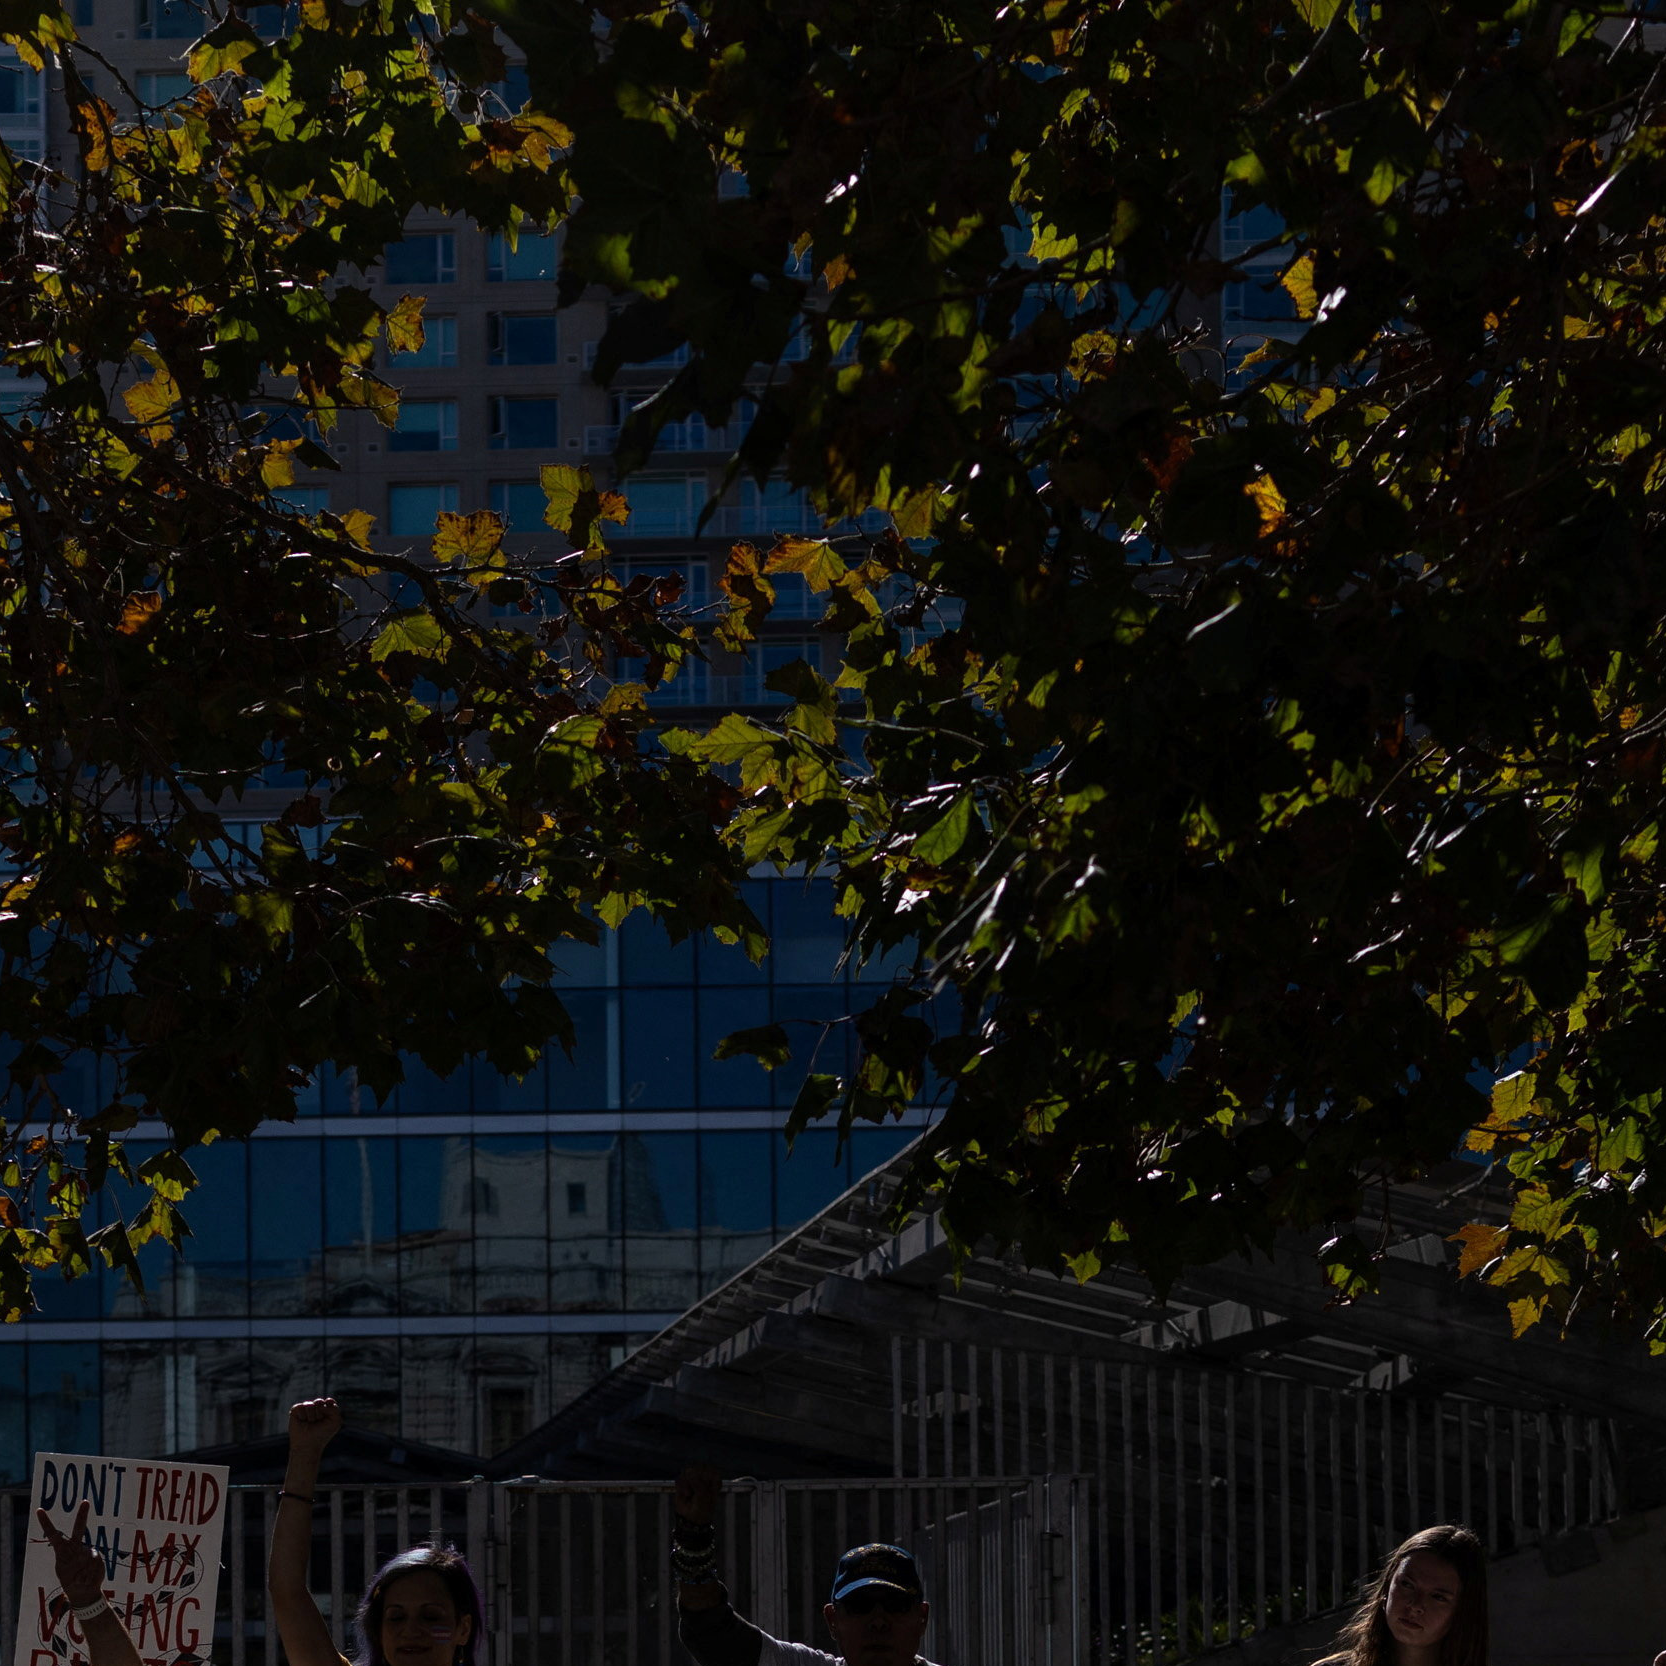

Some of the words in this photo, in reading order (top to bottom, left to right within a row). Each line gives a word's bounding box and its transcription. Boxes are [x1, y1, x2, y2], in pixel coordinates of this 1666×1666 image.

[40, 1460, 127, 1517] DON'T
[136, 1467, 220, 1526] TREAD
[129, 1530, 201, 1587] MY
